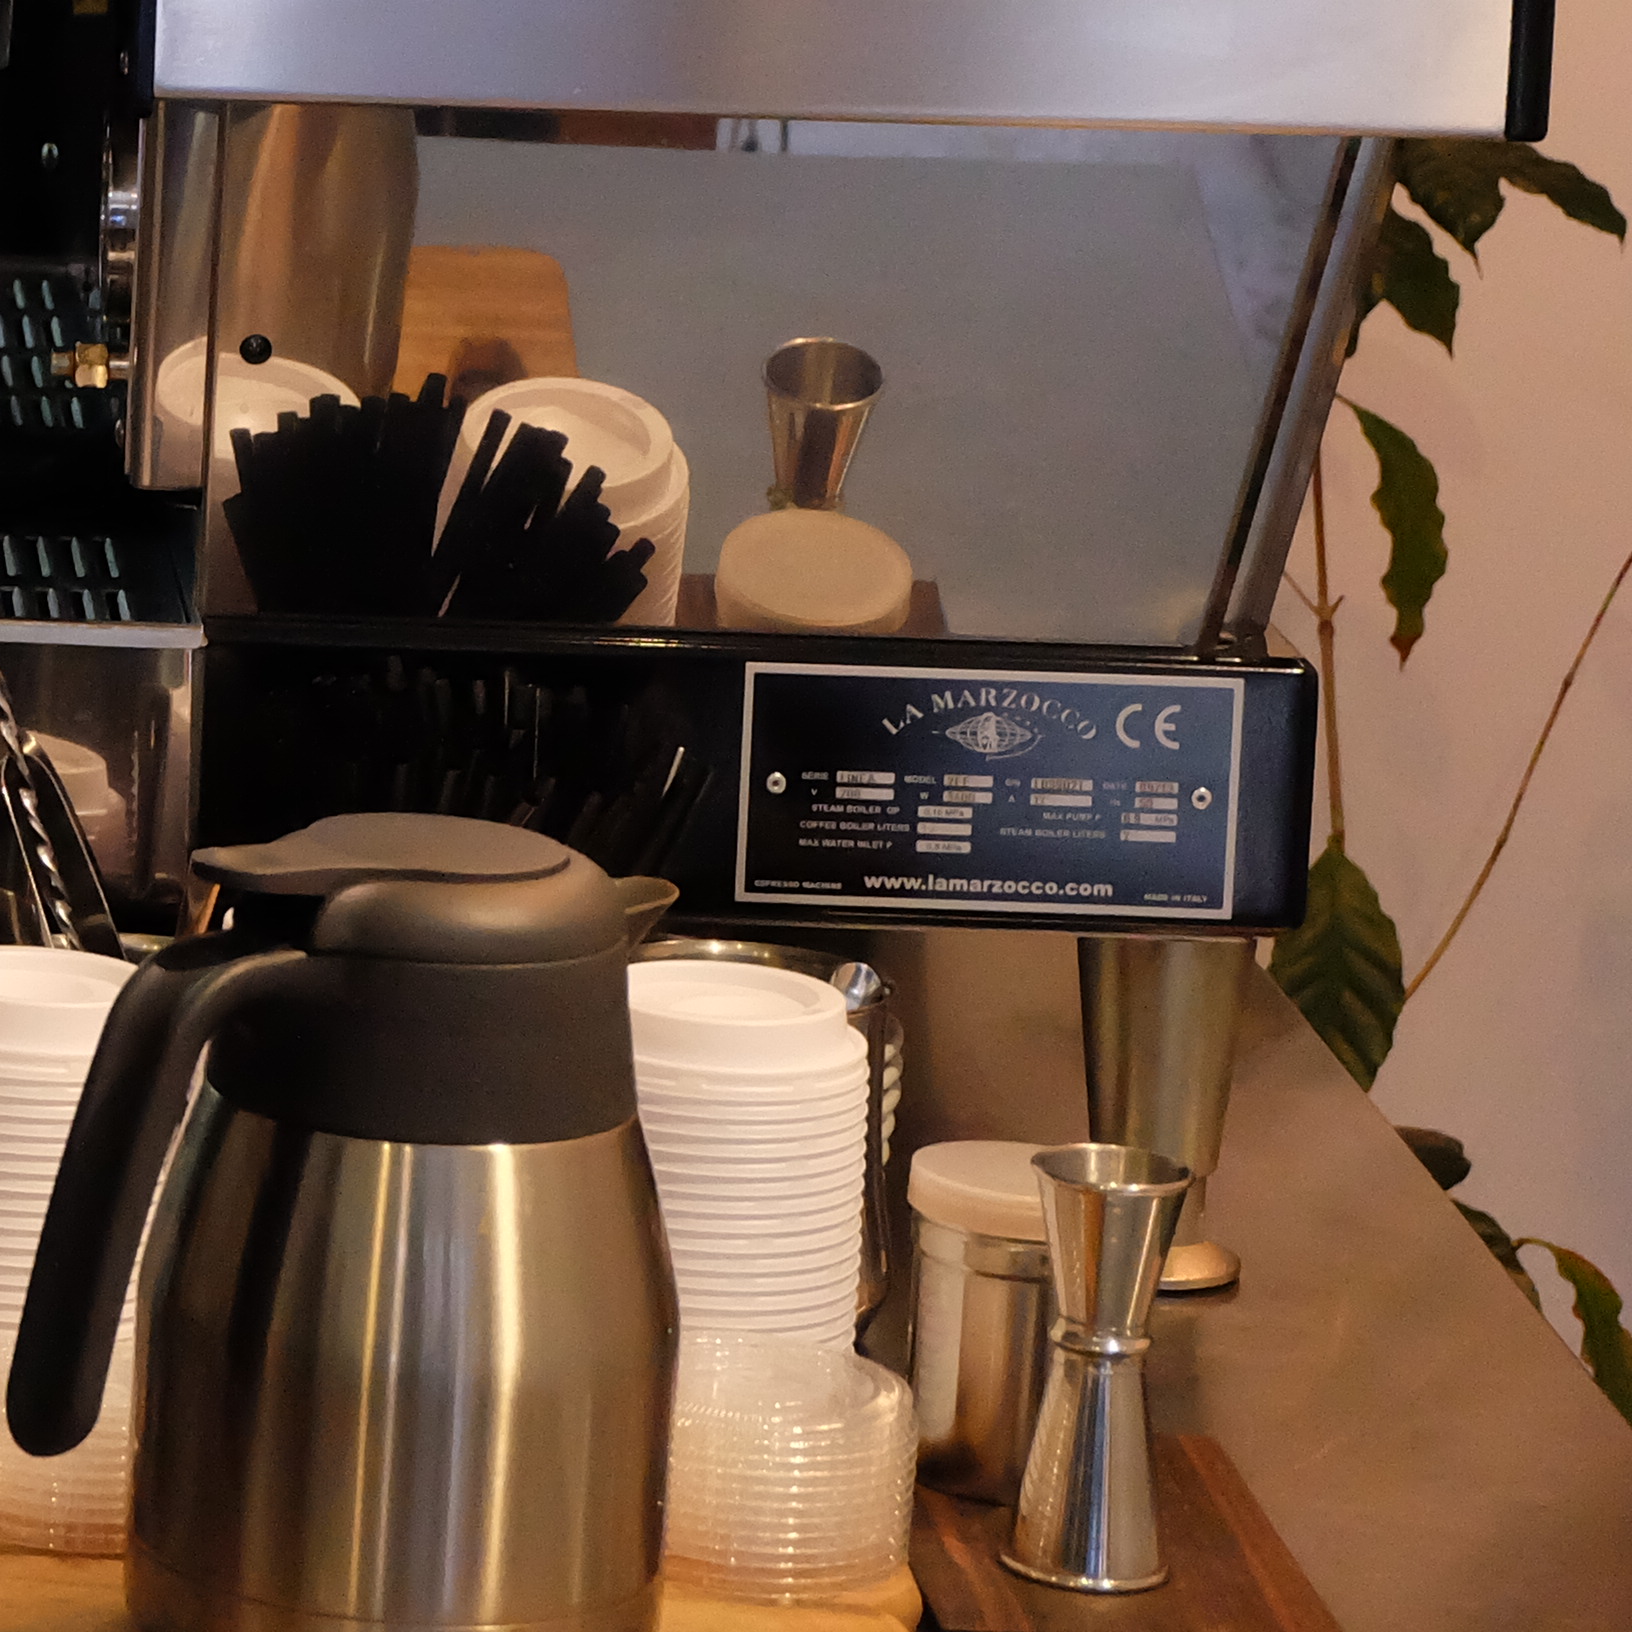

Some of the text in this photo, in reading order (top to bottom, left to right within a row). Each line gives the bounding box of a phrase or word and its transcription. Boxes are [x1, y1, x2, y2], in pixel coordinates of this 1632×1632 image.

[882, 687, 1097, 739] LA MARZOCCO
[1115, 703, 1182, 750] CE
[811, 788, 818, 796] V
[919, 791, 930, 800] W
[1008, 795, 1016, 803] A
[811, 804, 845, 813] STEAM
[846, 805, 882, 814] BOILER
[799, 821, 837, 830] COFFEE
[839, 822, 875, 831] BOILER
[1000, 828, 1032, 836] STEAM
[1035, 828, 1071, 838] BOILER
[799, 838, 820, 847] MAX
[822, 839, 855, 848] WATER
[863, 873, 1113, 897] www.lamarzocco.com
